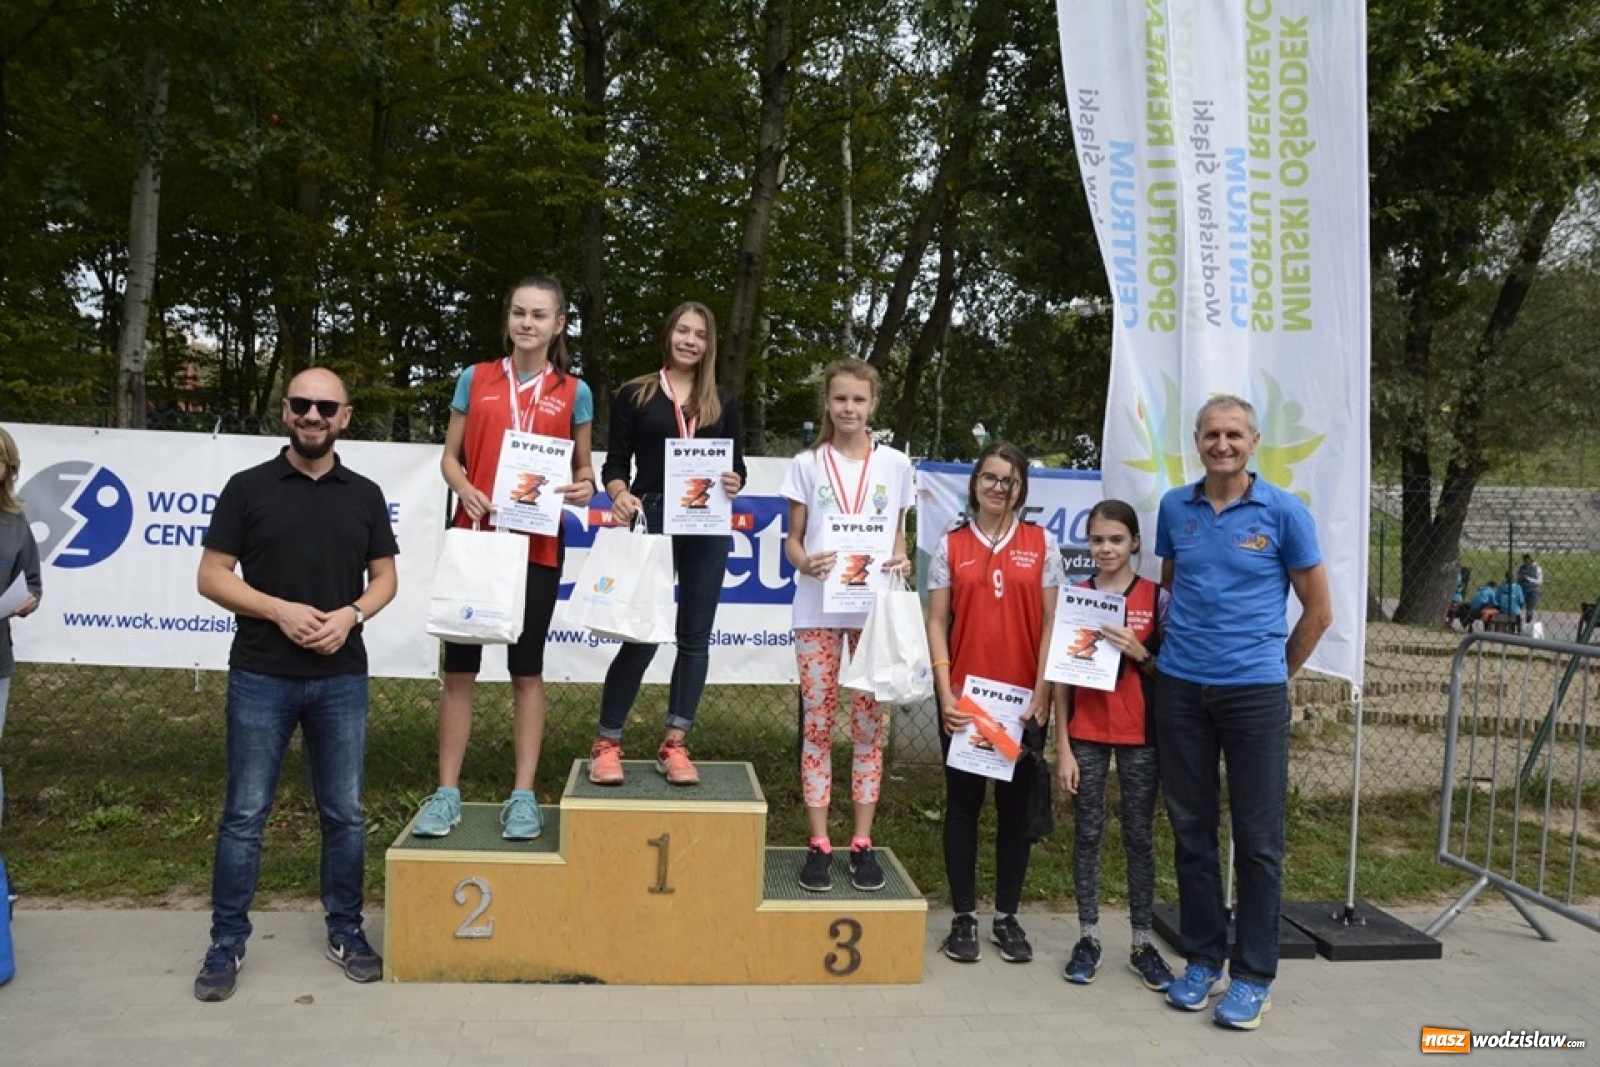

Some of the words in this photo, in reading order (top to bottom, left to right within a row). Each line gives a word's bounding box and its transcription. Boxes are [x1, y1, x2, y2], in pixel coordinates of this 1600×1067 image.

[511, 440, 566, 458] DYPLOM
[673, 448, 726, 458] DYPLOM
[832, 524, 884, 533] DYPLOM
[992, 568, 1005, 598] 9
[1066, 595, 1119, 613] DYPLOM
[972, 686, 1024, 705] DYPLOM
[647, 833, 676, 895] 1
[453, 877, 495, 939] 2
[824, 918, 863, 976] 3
